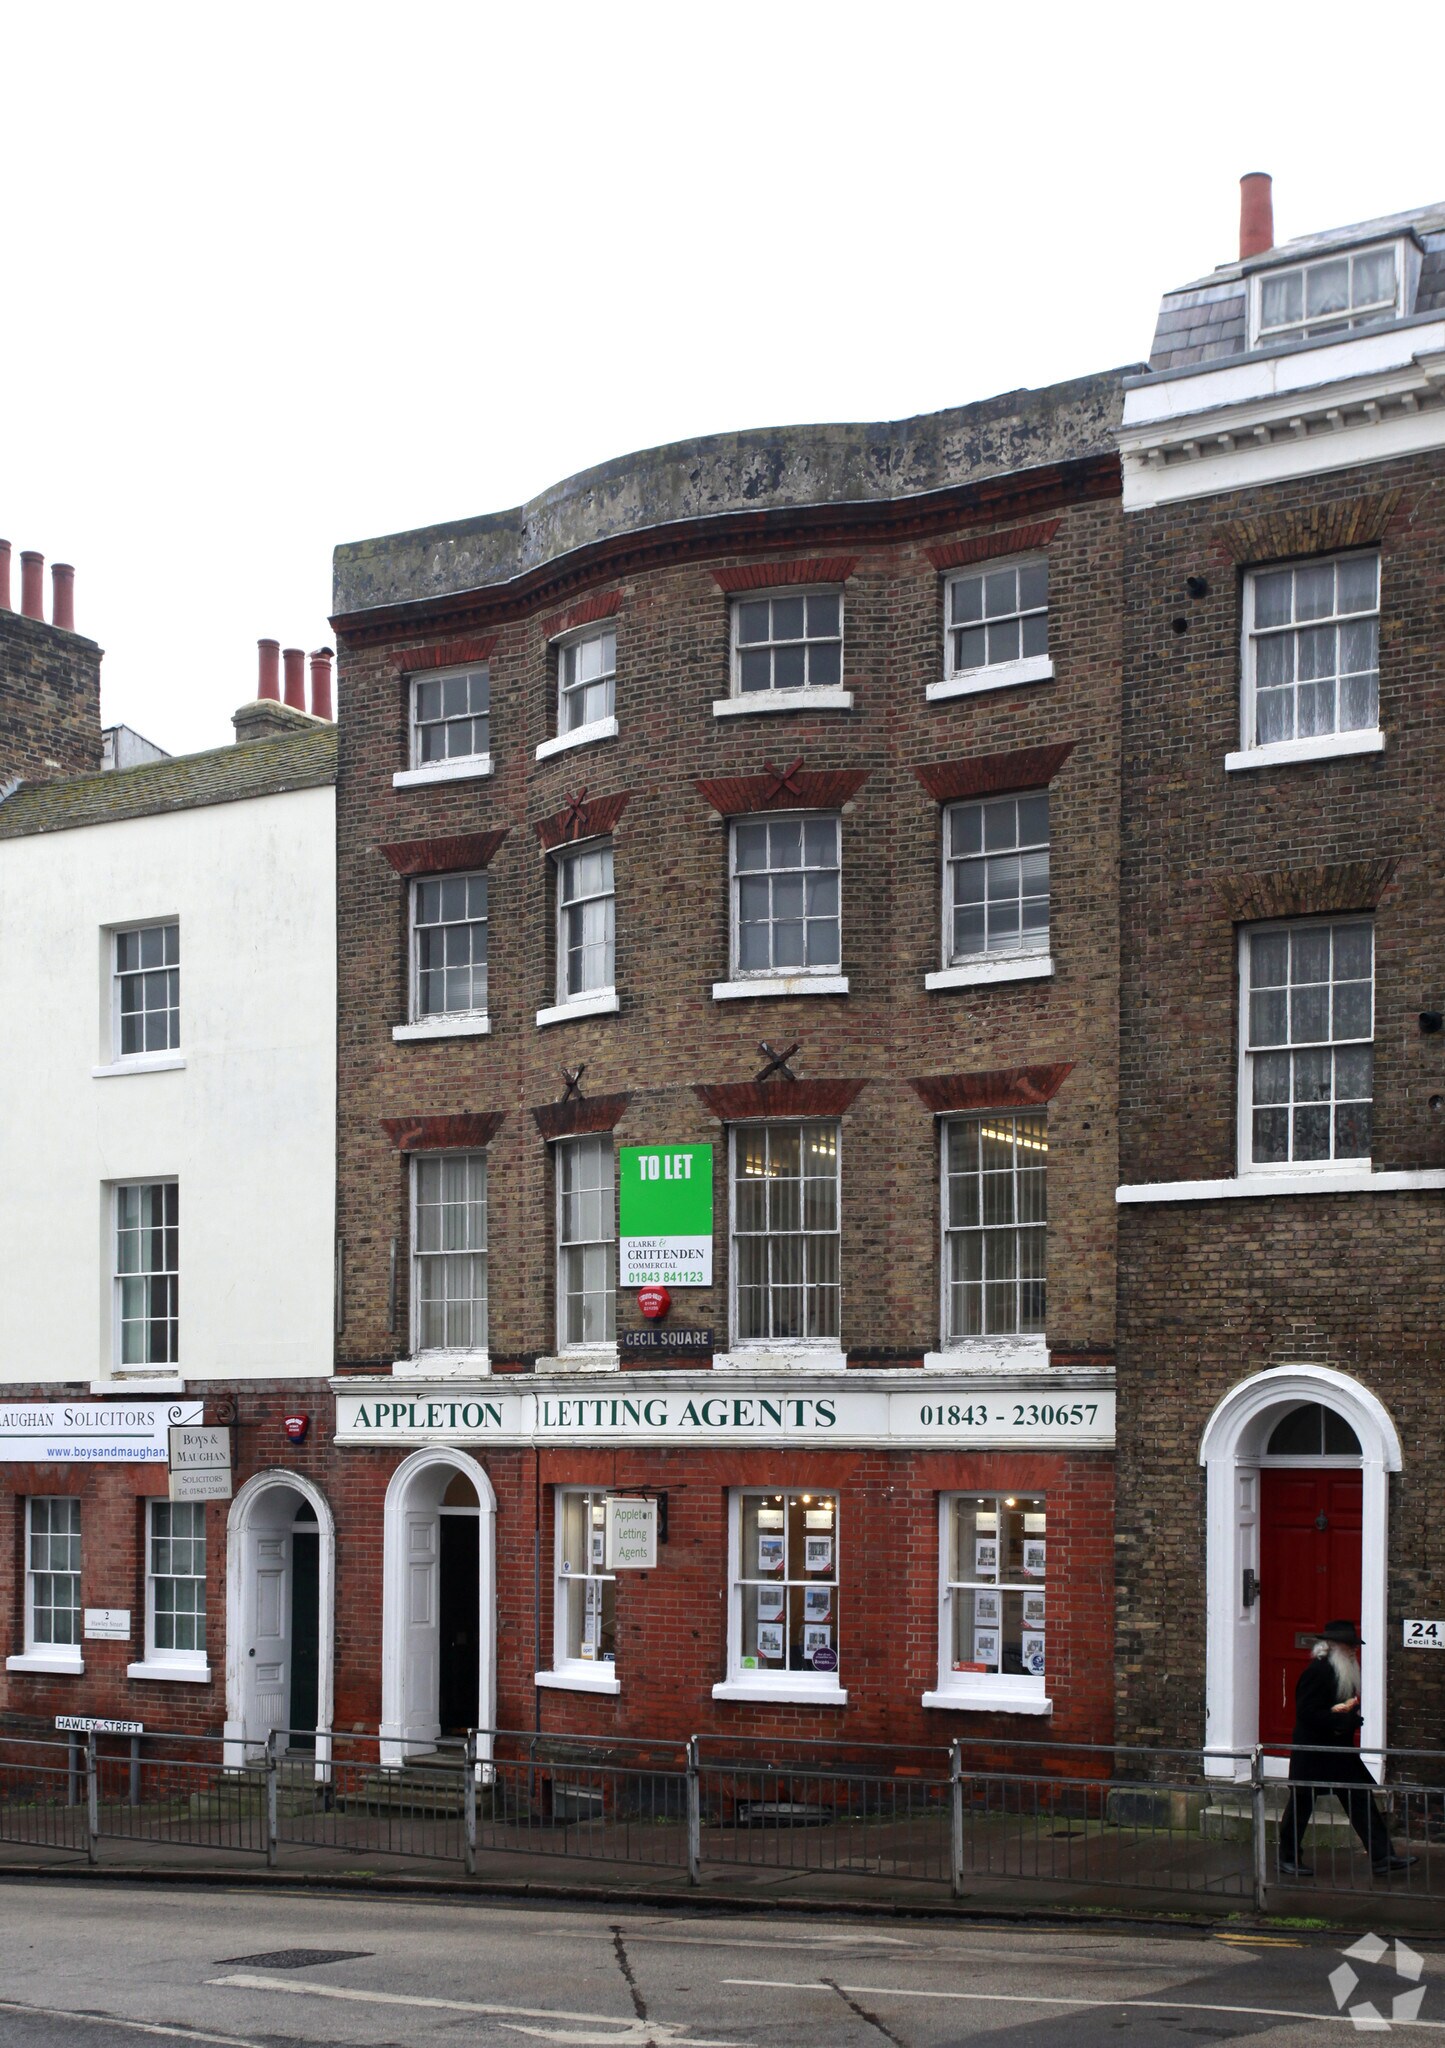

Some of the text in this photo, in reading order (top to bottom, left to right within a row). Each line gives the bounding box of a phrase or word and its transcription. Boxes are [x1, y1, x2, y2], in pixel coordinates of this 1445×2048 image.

[638, 1154, 693, 1181] TO LET
[627, 1238, 666, 1248] CLARKE &
[627, 1249, 704, 1260] CRITTENDEN
[628, 1262, 677, 1270] COMMERCIAL
[628, 1271, 703, 1283] 01843 841123
[626, 1331, 708, 1346] CECIL SQUARE
[64, 1408, 155, 1426] SOLICITORS
[353, 1402, 504, 1428] APPLETON
[543, 1400, 668, 1426] LETTING
[678, 1399, 837, 1427] AGENTS
[920, 1404, 988, 1426] 01843
[1012, 1404, 1098, 1426] 230657
[210, 1434, 218, 1444] &
[177, 1452, 226, 1462] MAUGHAN
[615, 1508, 653, 1522] Appleton
[619, 1528, 647, 1542] Letting
[618, 1546, 648, 1561] Agents
[105, 1611, 110, 1620] 2
[1411, 1623, 1438, 1638] 24
[57, 1717, 97, 1730] HAWLEY
